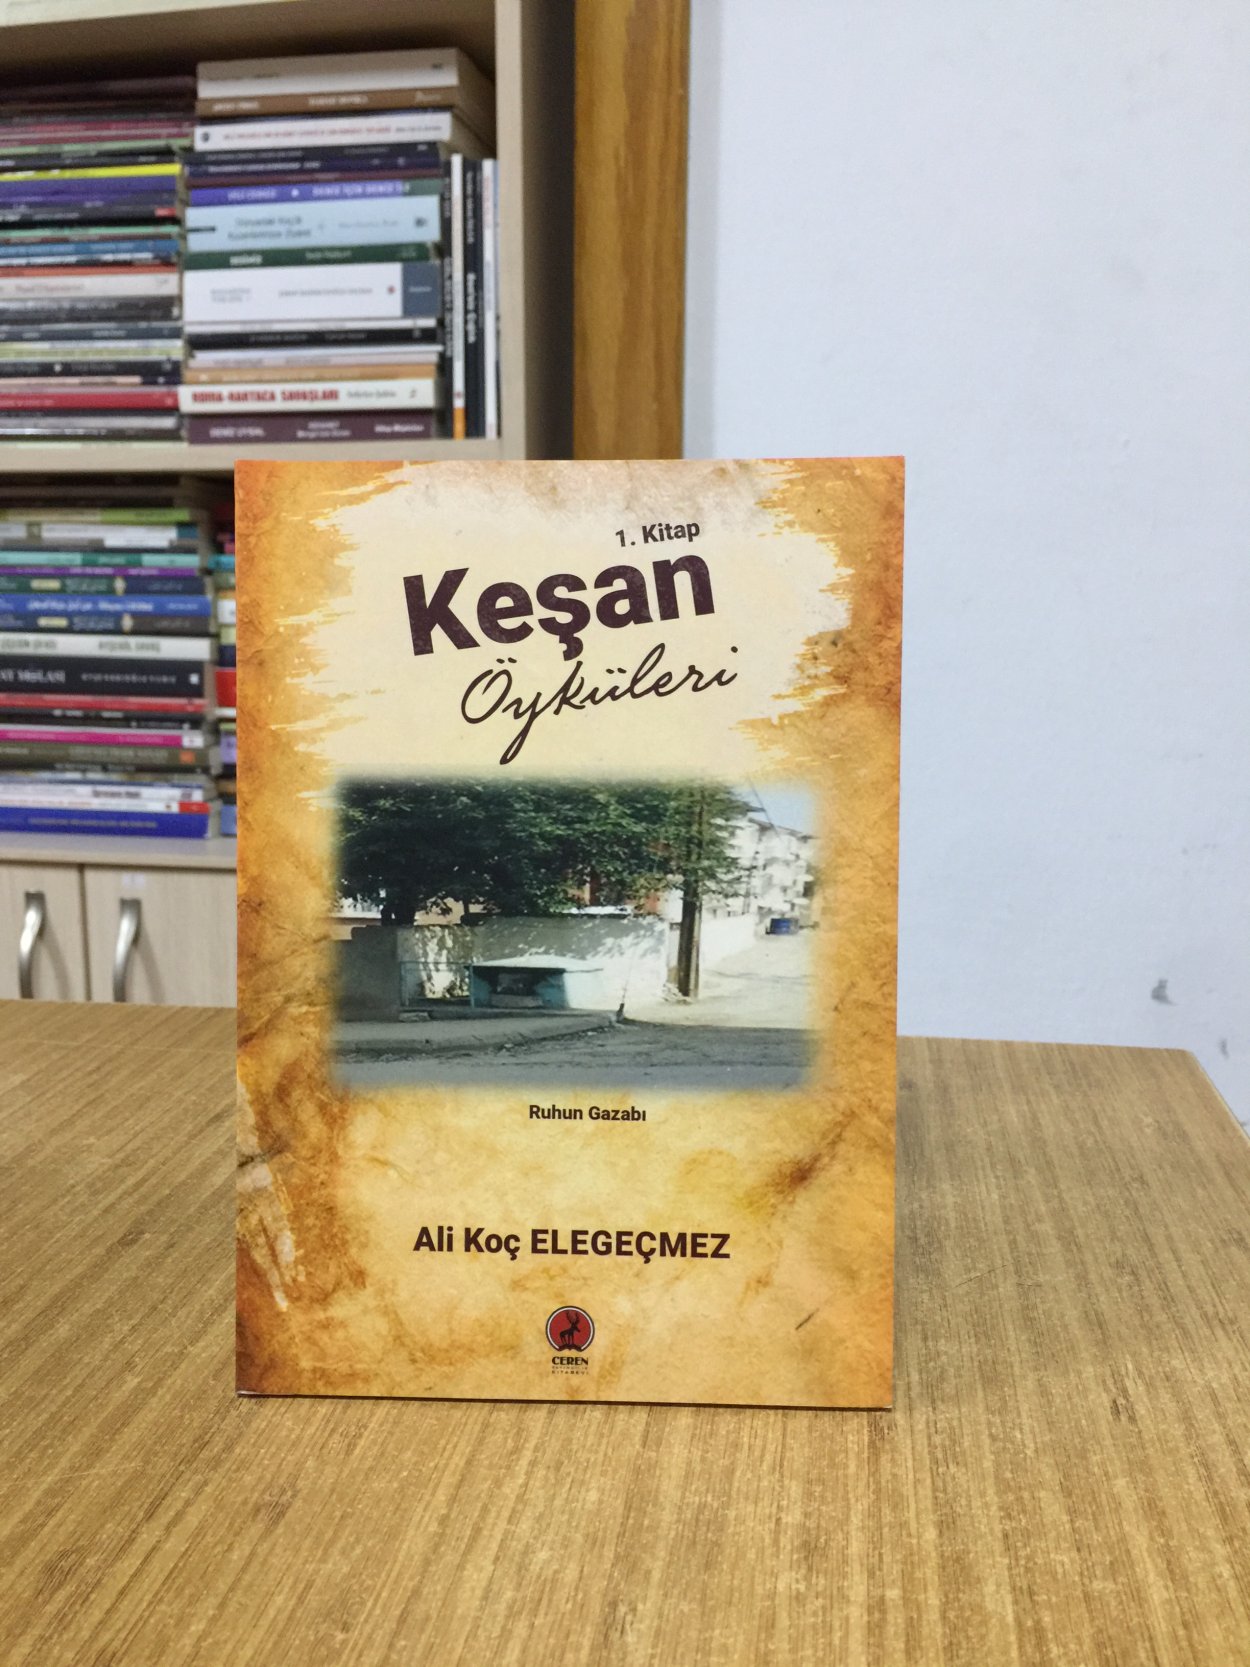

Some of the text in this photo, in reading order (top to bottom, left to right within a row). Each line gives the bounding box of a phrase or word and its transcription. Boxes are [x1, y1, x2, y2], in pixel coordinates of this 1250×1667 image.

[615, 522, 700, 547] 1. Kitap
[403, 554, 715, 662] Keşan
[461, 642, 739, 765] Öyküleri
[529, 1104, 647, 1121] Ruhun Gazabı
[413, 1226, 731, 1264] Ali Koç ELEGEÇMEZ
[551, 1356, 589, 1366] CEREN
